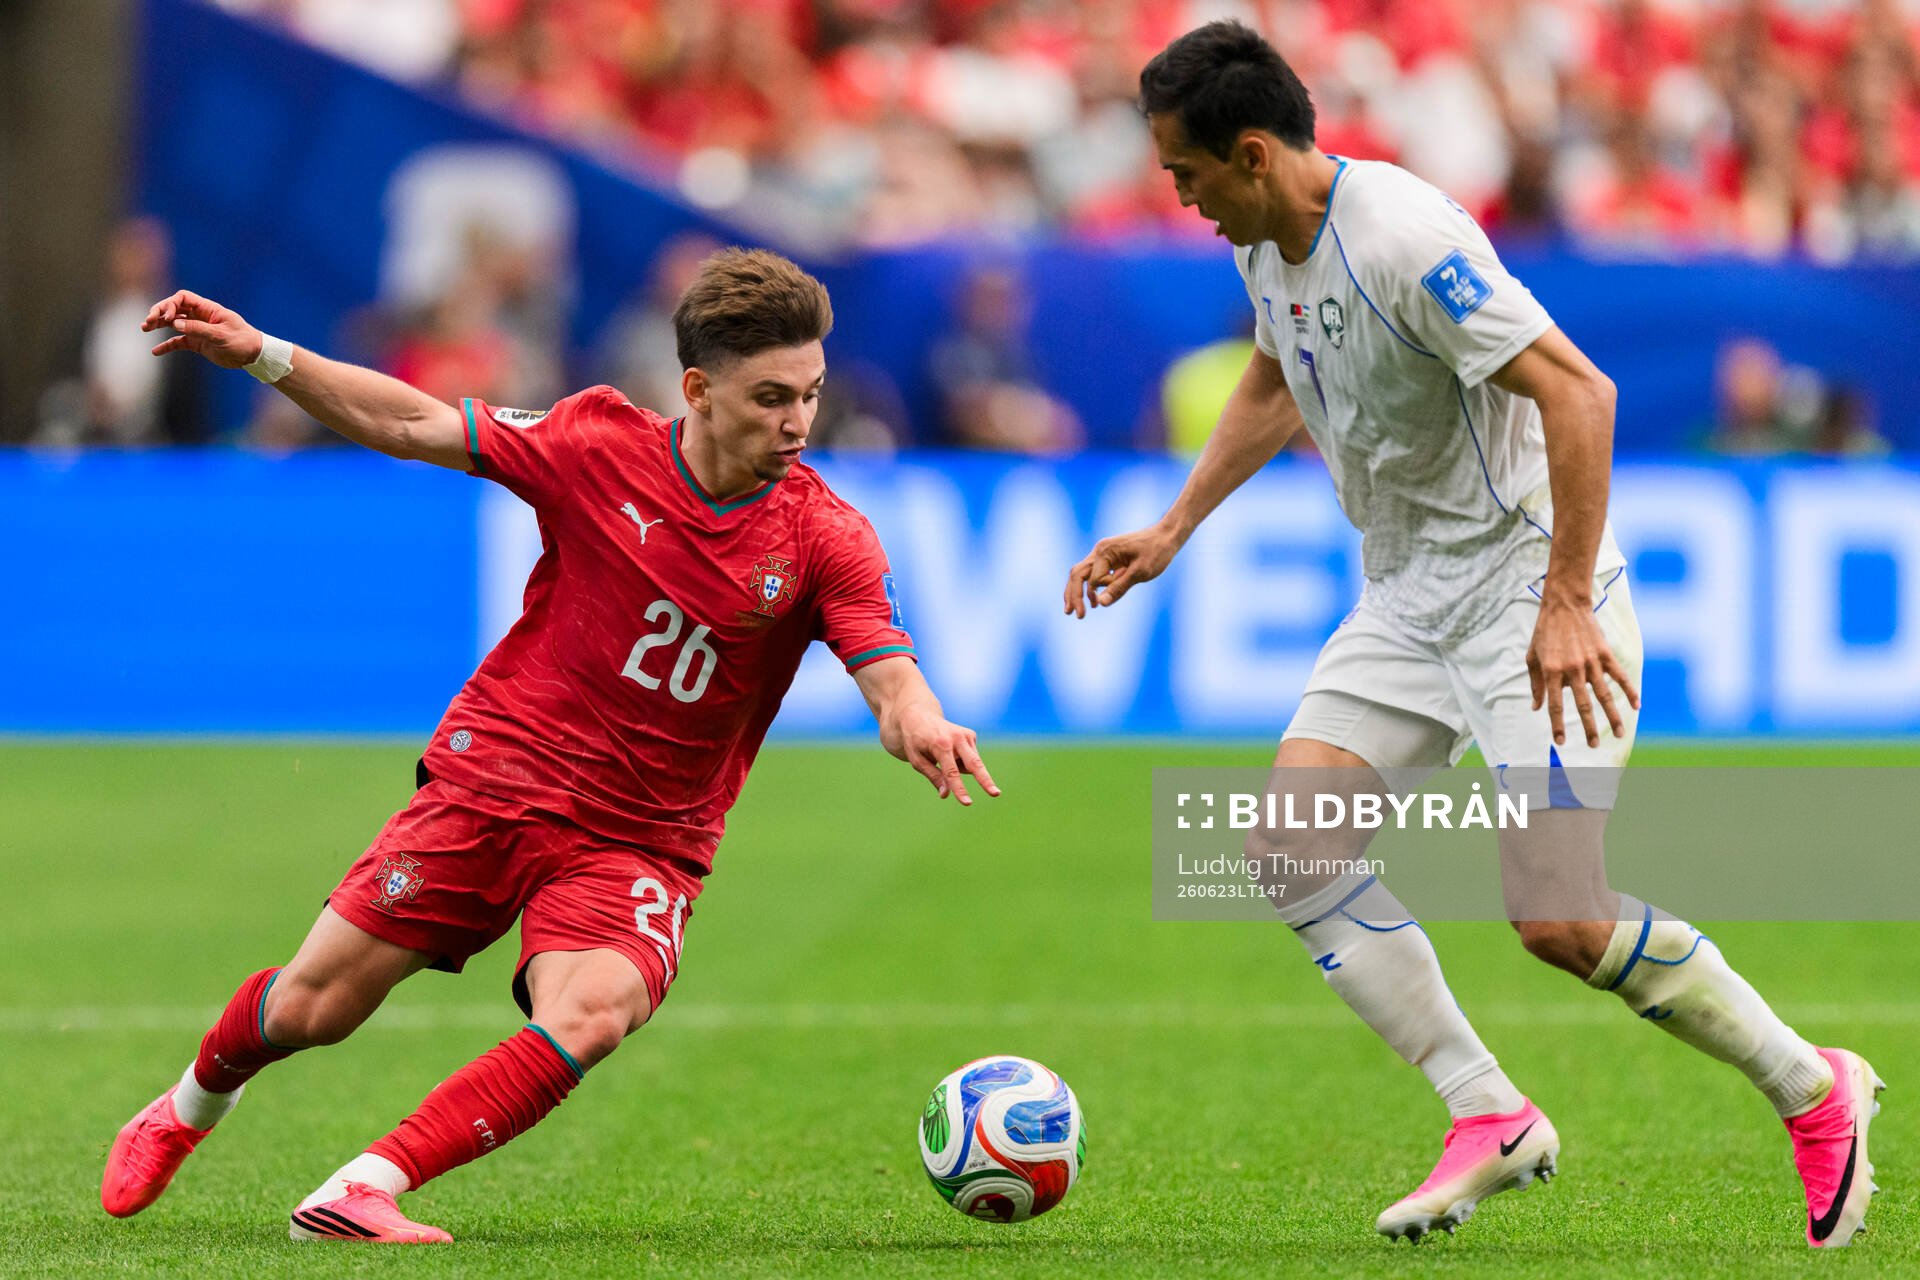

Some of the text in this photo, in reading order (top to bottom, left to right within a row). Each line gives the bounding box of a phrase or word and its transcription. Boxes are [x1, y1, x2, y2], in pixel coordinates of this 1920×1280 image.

[1321, 304, 1344, 330] UFA
[1298, 347, 1328, 420] 7
[621, 599, 718, 703] 26
